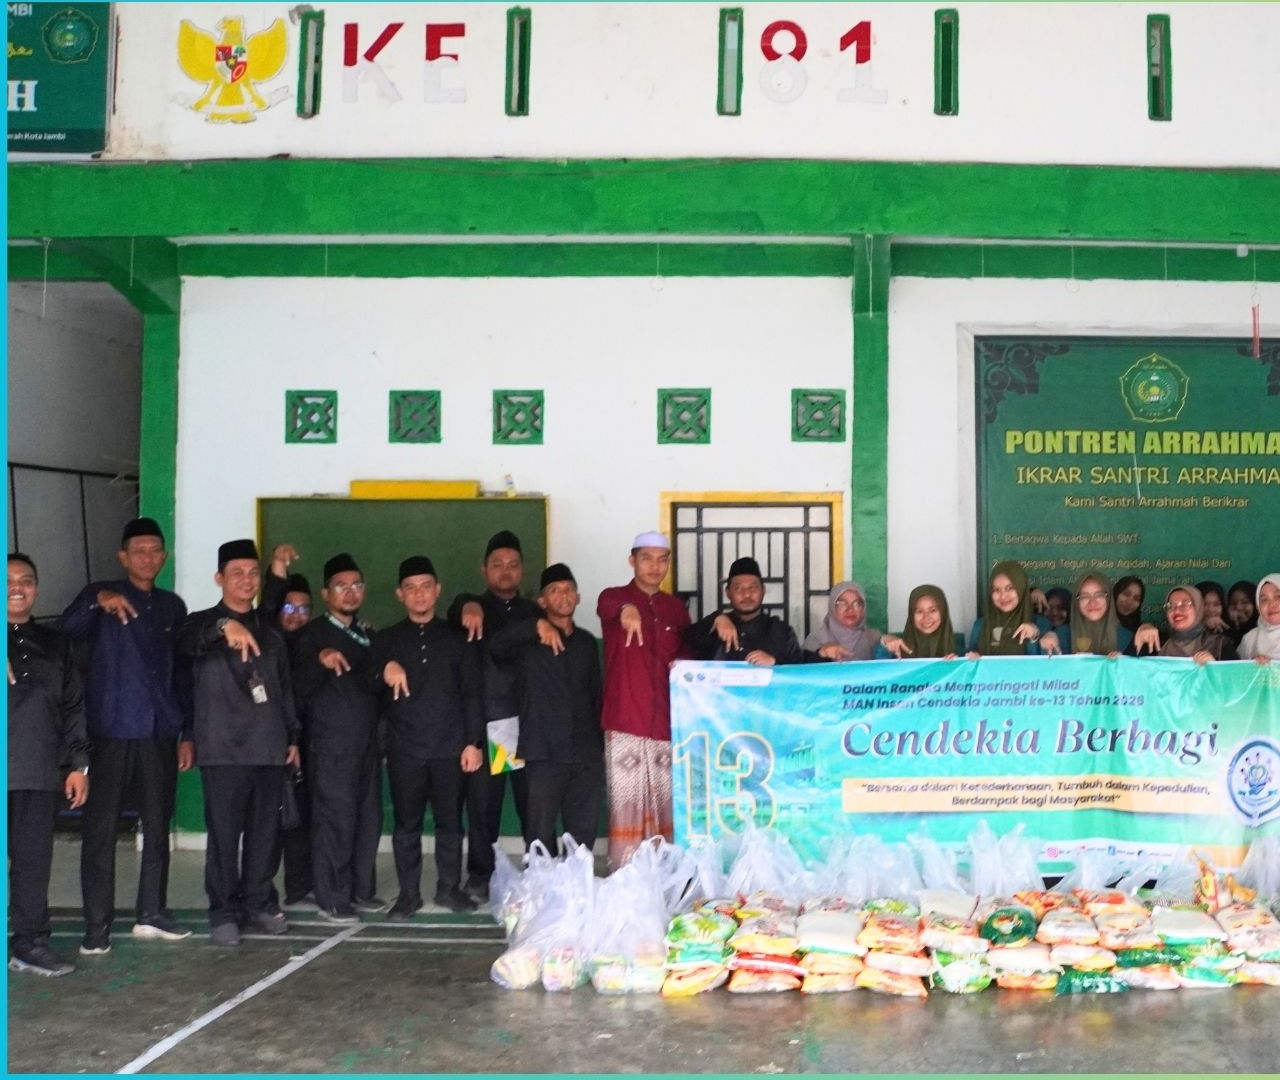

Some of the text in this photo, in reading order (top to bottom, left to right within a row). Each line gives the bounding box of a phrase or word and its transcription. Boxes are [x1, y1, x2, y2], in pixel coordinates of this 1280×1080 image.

[341, 20, 889, 104] KE 81
[24, 132, 43, 140] Kota
[43, 132, 67, 140] Jambi
[1005, 430, 1136, 455] PONTREN
[1016, 466, 1082, 484] IKRAR
[1090, 466, 1169, 484] SANTRI
[1064, 496, 1250, 508] Kami Santri Arrahmah Berikrar
[1053, 534, 1088, 546] Kepada
[1090, 533, 1114, 544] Allah
[1060, 560, 1089, 572] Teguh
[1091, 560, 1115, 569] Pada
[842, 683, 887, 695] Dalam
[944, 679, 1039, 696] Memperingati
[1042, 679, 1081, 691] Milad
[842, 699, 875, 710] MAN
[917, 696, 981, 709] Cendekia
[983, 695, 1026, 708] Jambi
[1029, 695, 1066, 707] ke-13
[1069, 694, 1111, 706] Tahun
[840, 718, 1220, 766] Cendekia Berbagi
[672, 731, 777, 840] 13
[920, 782, 958, 792] dalam
[1057, 779, 1103, 791] Tumbuh
[1104, 780, 1140, 792] dalam
[1142, 783, 1211, 795] Kepedulian,
[951, 796, 1019, 808] Berdampak
[1021, 794, 1048, 808] bagi
